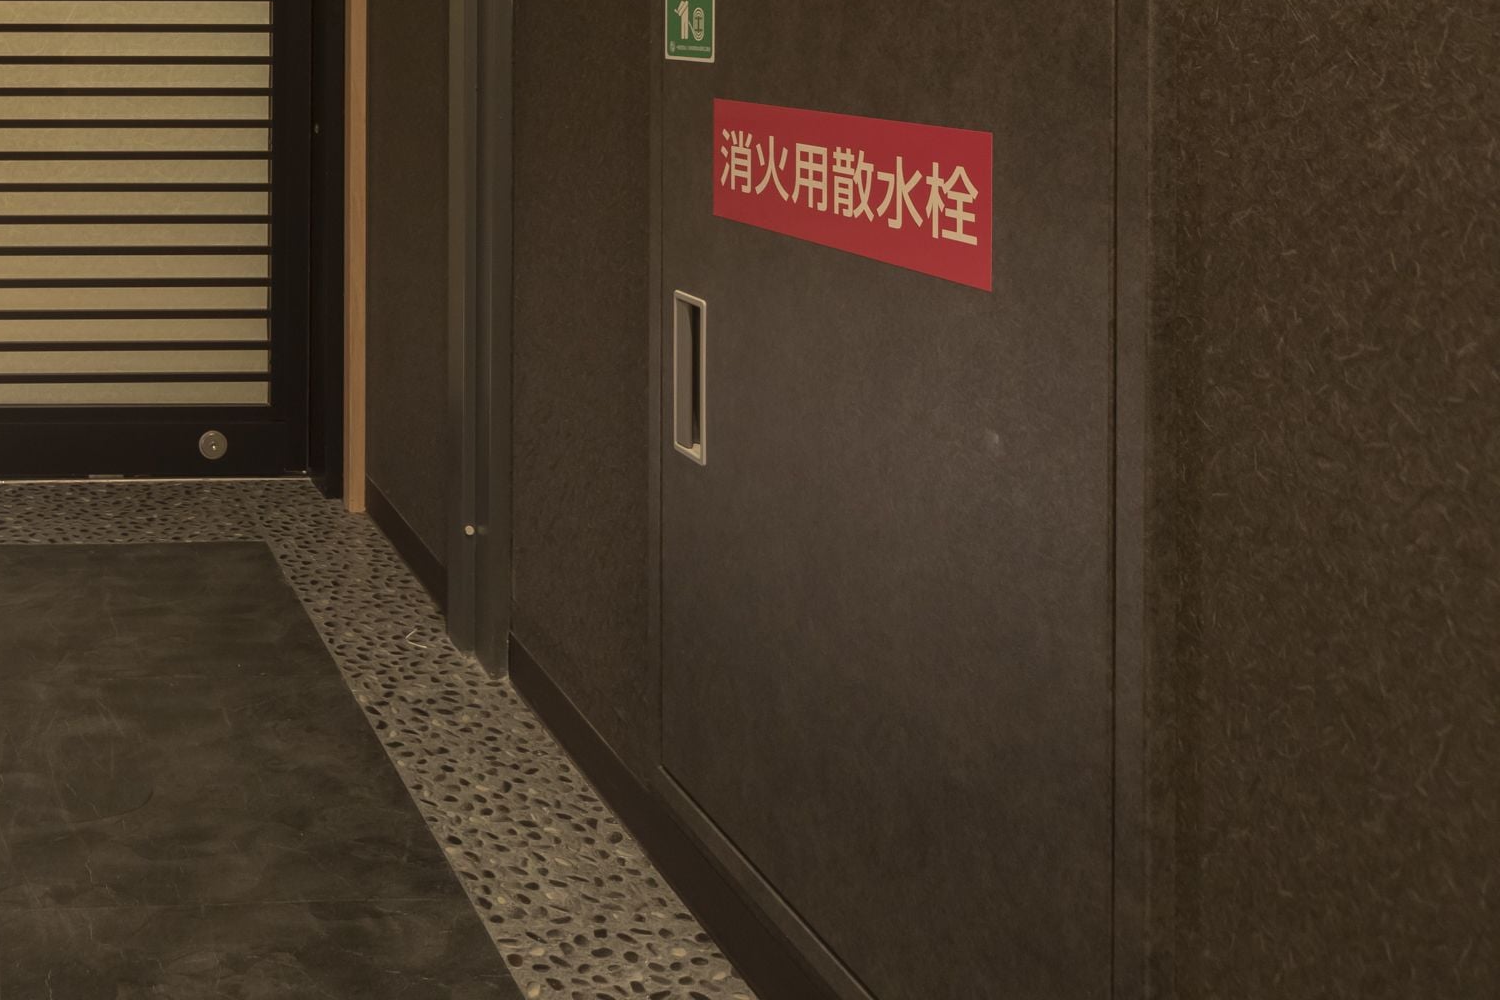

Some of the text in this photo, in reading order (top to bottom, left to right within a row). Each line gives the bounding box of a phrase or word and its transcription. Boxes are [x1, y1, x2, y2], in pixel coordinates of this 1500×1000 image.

[720, 128, 979, 246] 消火用散水栓
